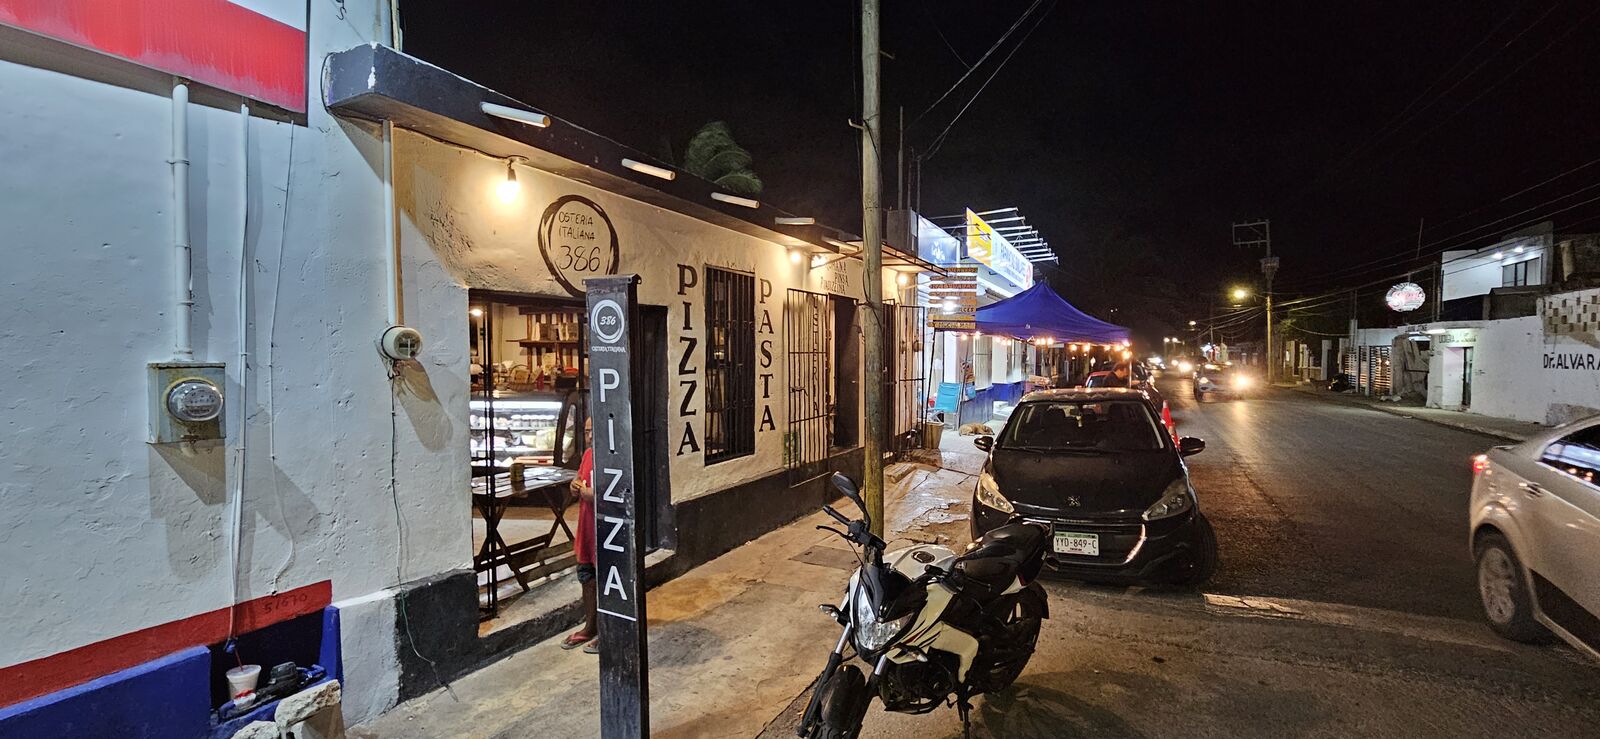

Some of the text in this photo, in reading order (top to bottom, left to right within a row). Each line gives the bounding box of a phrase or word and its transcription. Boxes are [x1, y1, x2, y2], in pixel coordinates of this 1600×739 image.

[558, 211, 594, 226] OSTERIA
[558, 226, 596, 241] ITALIANA
[558, 245, 601, 272] 386
[599, 315, 617, 326] 386
[676, 263, 700, 456] PIZZA
[758, 277, 776, 433] PASTA
[598, 368, 628, 602] PIZZA
[1055, 537, 1097, 549] YYD-849-C
